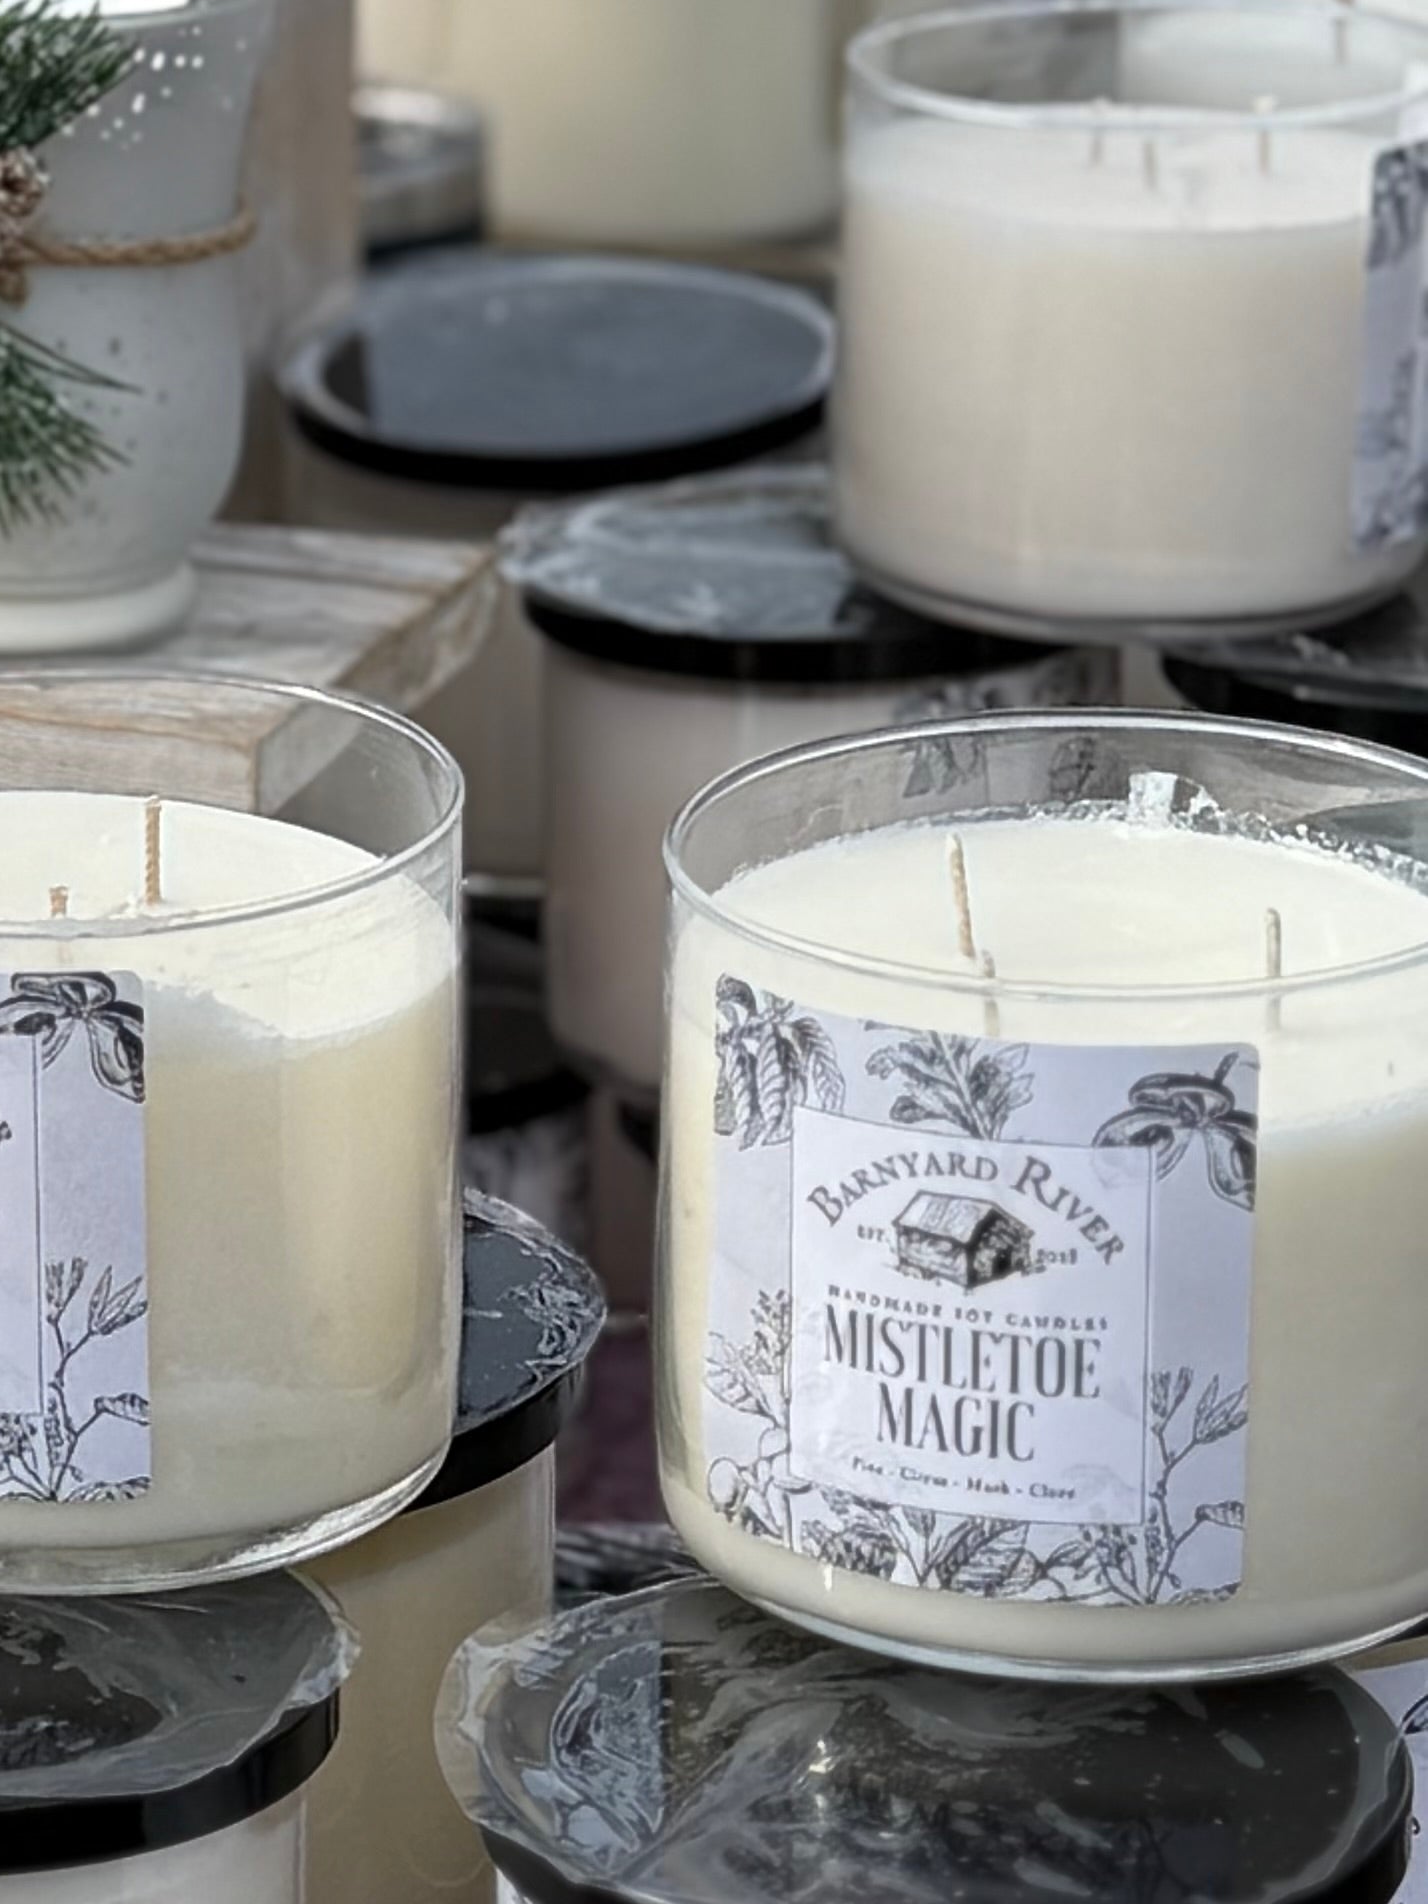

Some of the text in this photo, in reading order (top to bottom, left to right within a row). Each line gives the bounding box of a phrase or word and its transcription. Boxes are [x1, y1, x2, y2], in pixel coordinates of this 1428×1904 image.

[807, 1151, 1124, 1265] BARNYARD RIVER
[824, 1303, 1101, 1399] MISTLETOE
[877, 1381, 1035, 1462] MAGIC
